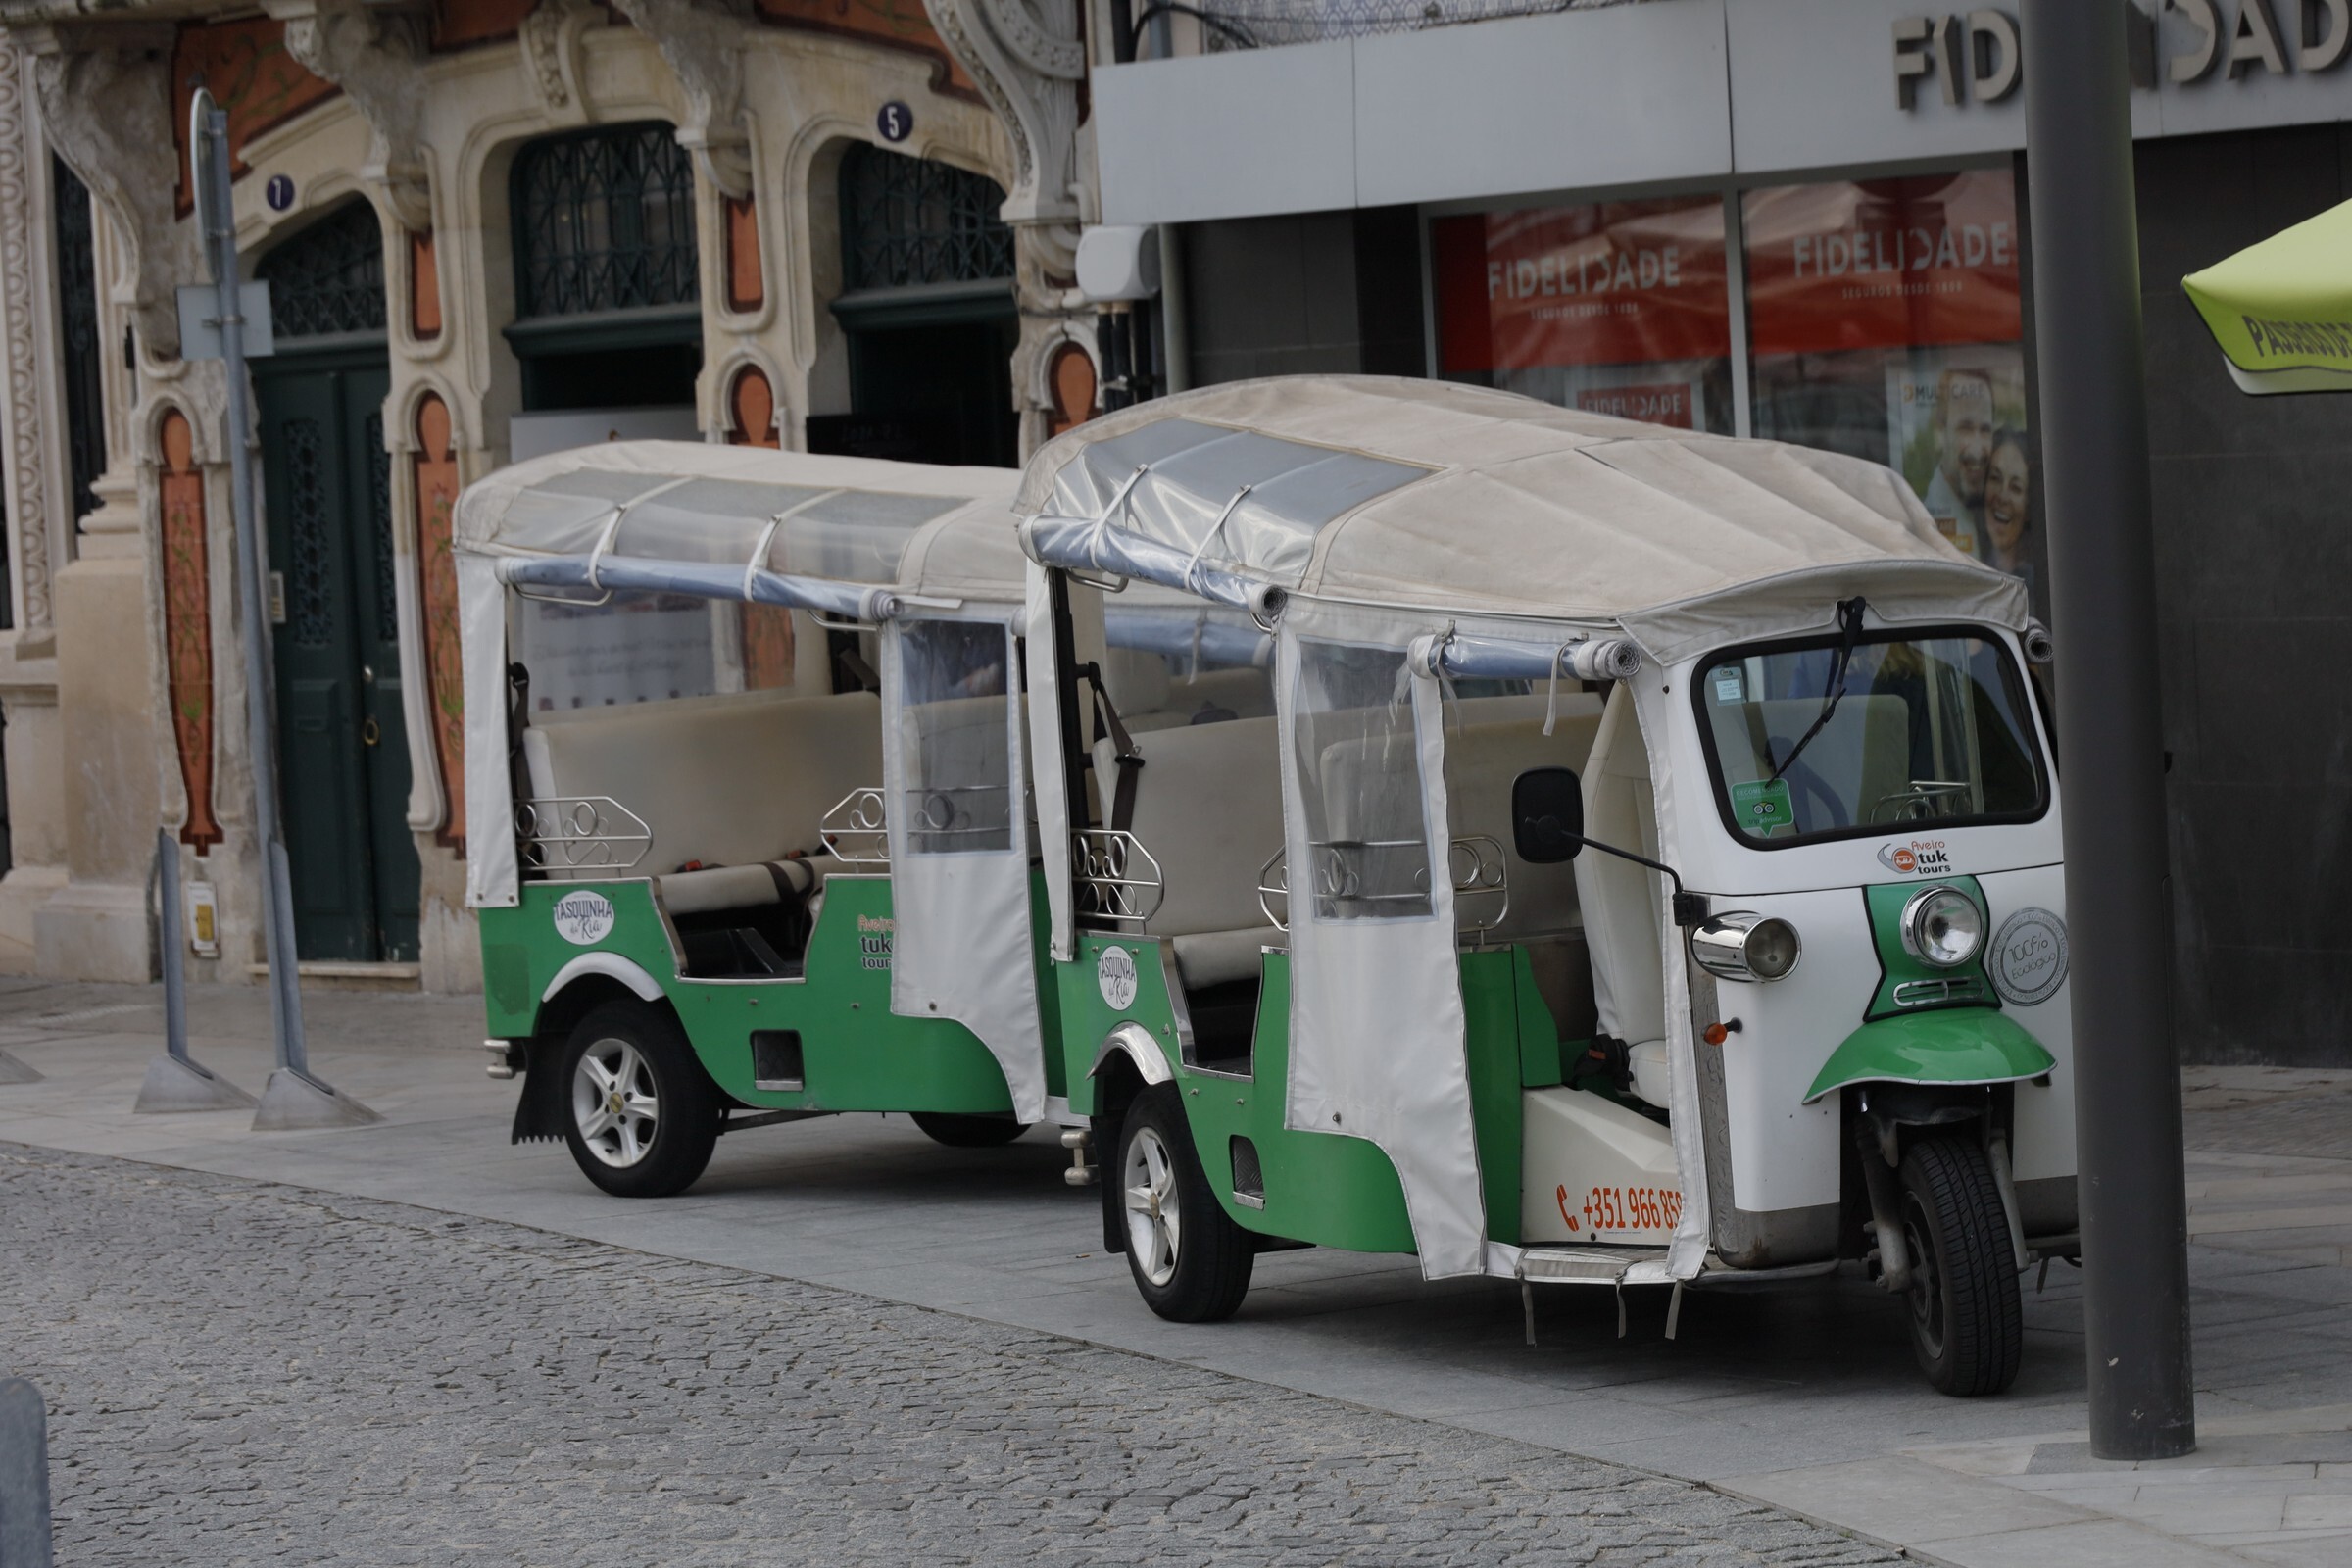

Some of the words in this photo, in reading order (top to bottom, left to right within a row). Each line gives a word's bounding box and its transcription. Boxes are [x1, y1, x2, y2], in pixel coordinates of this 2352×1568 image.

[886, 105, 900, 138] 5
[1792, 221, 2010, 278] FIDELIDADE
[1488, 246, 1681, 301] FIDELIDADE
[1911, 840, 1945, 851] Aveiro
[1918, 850, 1948, 864] tuk
[1918, 864, 1951, 875] tours
[554, 900, 612, 921] TASQUINHA
[860, 933, 893, 953] tuk
[2009, 932, 2049, 964] 100%
[862, 956, 893, 969] tour
[1584, 1187, 1626, 1229] +351
[1628, 1187, 1661, 1229] 966
